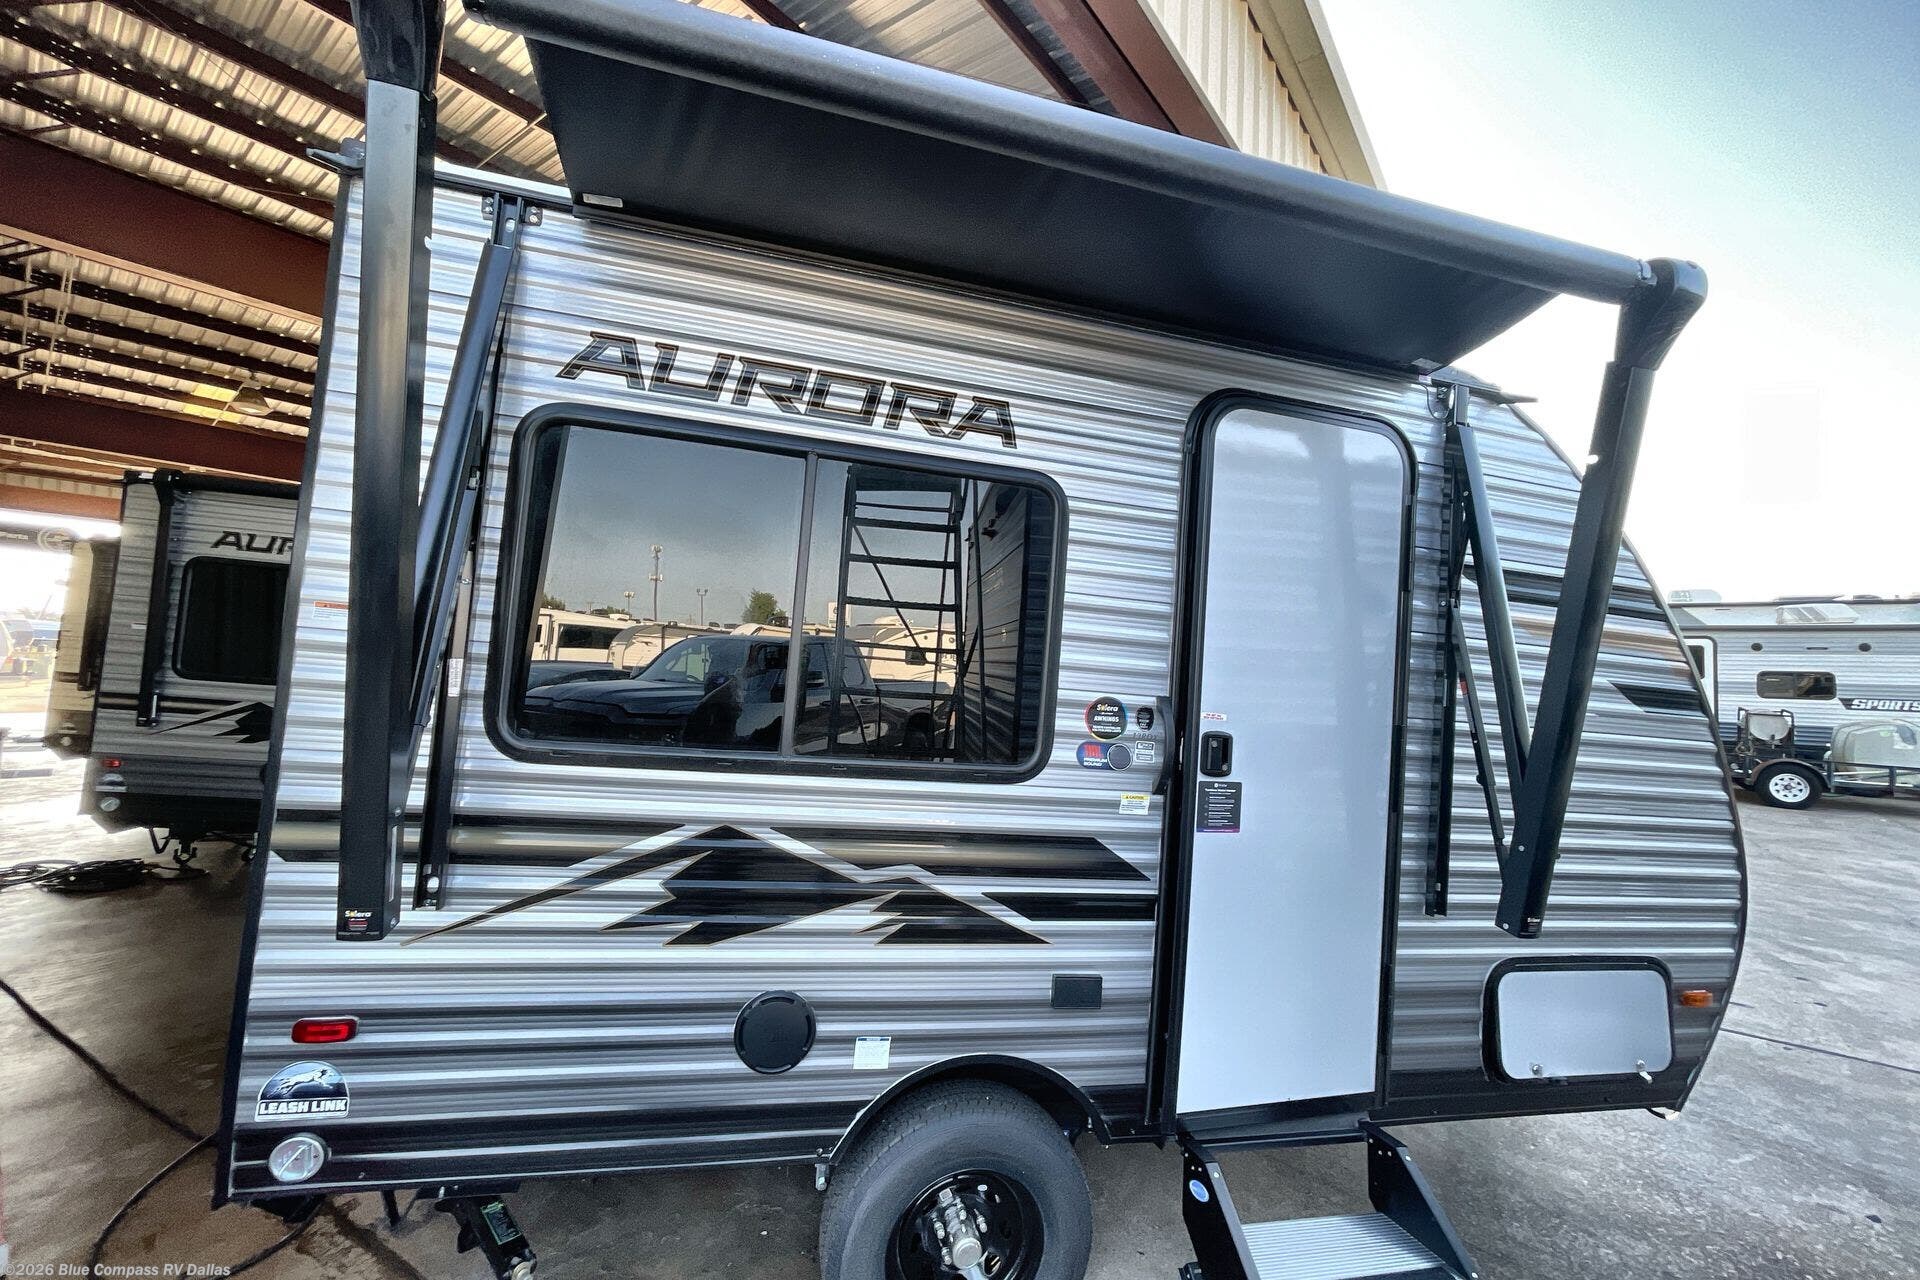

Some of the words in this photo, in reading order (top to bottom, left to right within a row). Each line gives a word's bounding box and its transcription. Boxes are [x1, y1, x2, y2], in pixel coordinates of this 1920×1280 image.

[555, 331, 1018, 449] AURORA
[259, 1101, 309, 1115] LEASH
[311, 1099, 347, 1112] LINK
